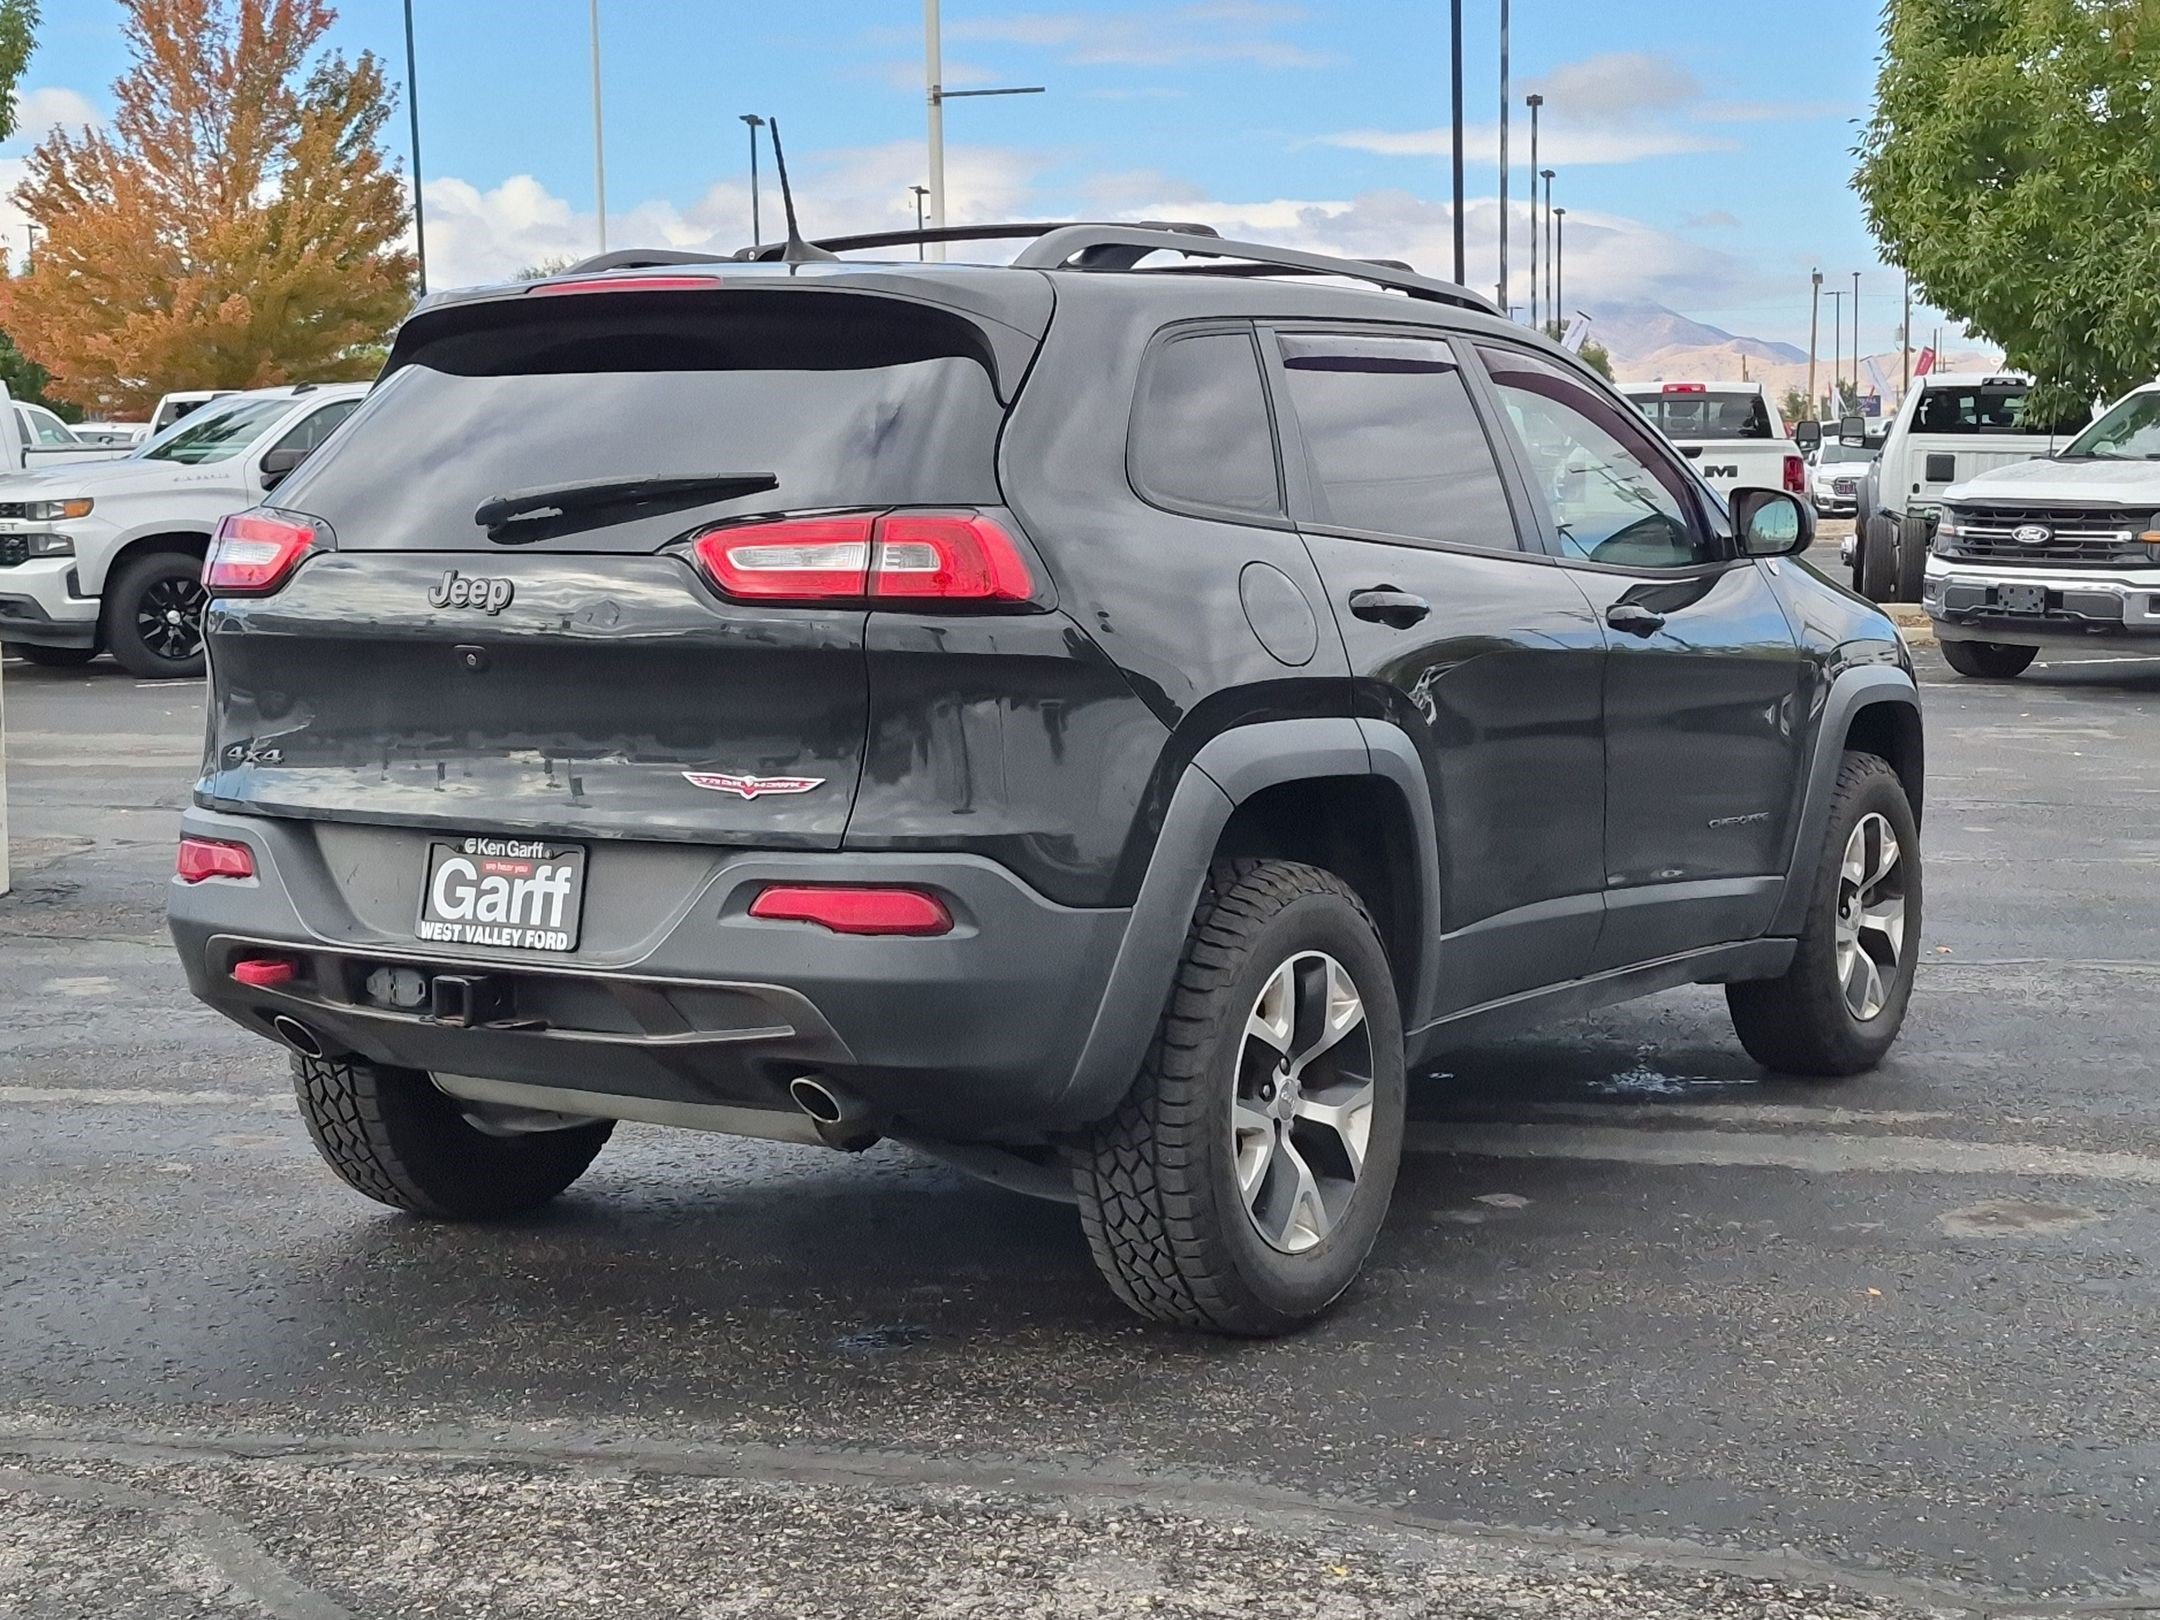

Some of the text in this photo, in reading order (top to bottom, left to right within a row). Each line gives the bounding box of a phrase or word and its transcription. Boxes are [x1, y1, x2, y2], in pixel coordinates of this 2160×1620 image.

[428, 570, 514, 616] Jeep
[227, 746, 284, 764] 4x4
[477, 838, 505, 856] Ken
[507, 840, 544, 859] Garff
[432, 857, 572, 928] Garff
[420, 921, 568, 951] WEST VALLEY FORD
